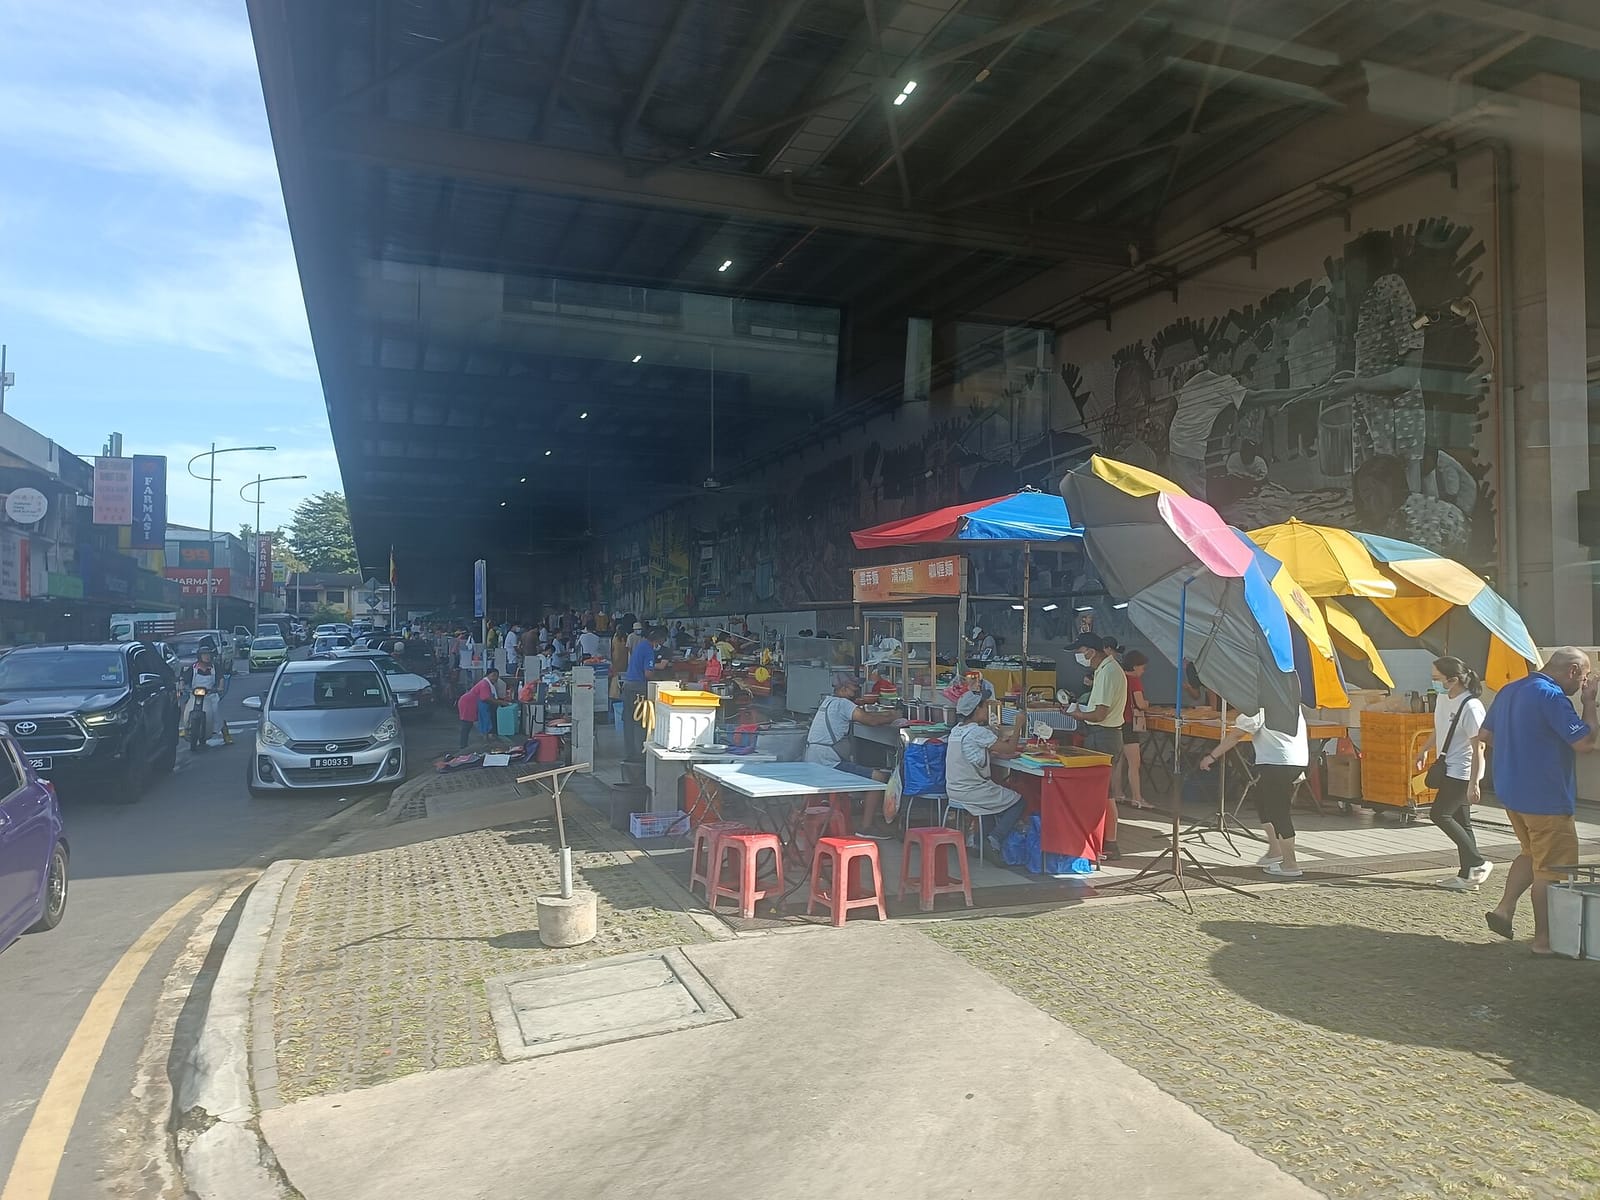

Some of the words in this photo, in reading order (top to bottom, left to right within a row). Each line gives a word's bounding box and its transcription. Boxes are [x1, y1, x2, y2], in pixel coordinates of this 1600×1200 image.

[142, 477, 153, 540] FARMASI
[165, 577, 223, 586] HARMACY
[259, 541, 267, 587] FARMASI
